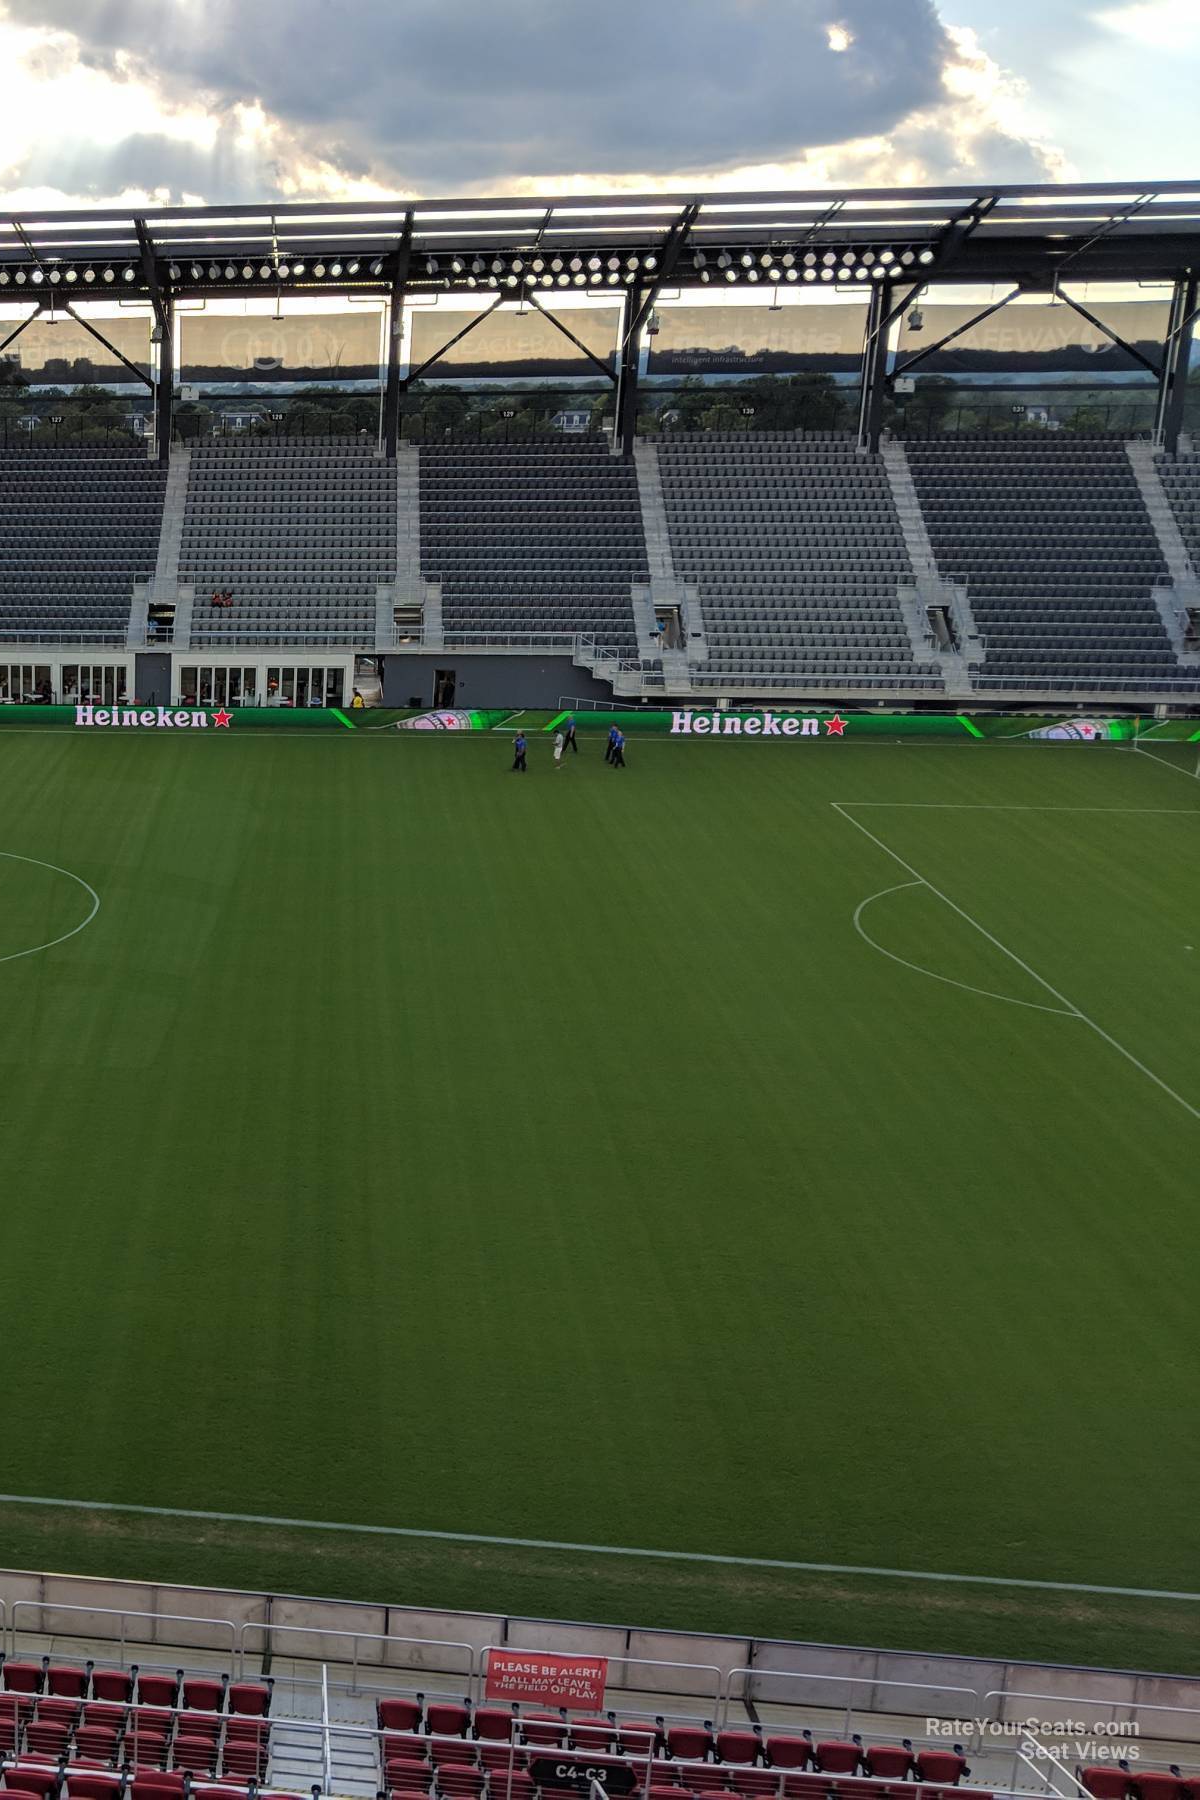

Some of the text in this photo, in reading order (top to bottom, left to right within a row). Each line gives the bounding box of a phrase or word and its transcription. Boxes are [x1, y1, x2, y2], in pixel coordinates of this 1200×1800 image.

[671, 356, 764, 365] intelligent infrastructure
[74, 705, 208, 728] Heineken
[670, 711, 820, 736] Heineken
[493, 1662, 601, 1679] PLEASE BE ALERT!
[494, 1682, 598, 1700] THE FIELD OF PLAY.
[502, 1675, 591, 1690] BALL MAY LEAVE
[555, 1765, 607, 1781] C4-C3
